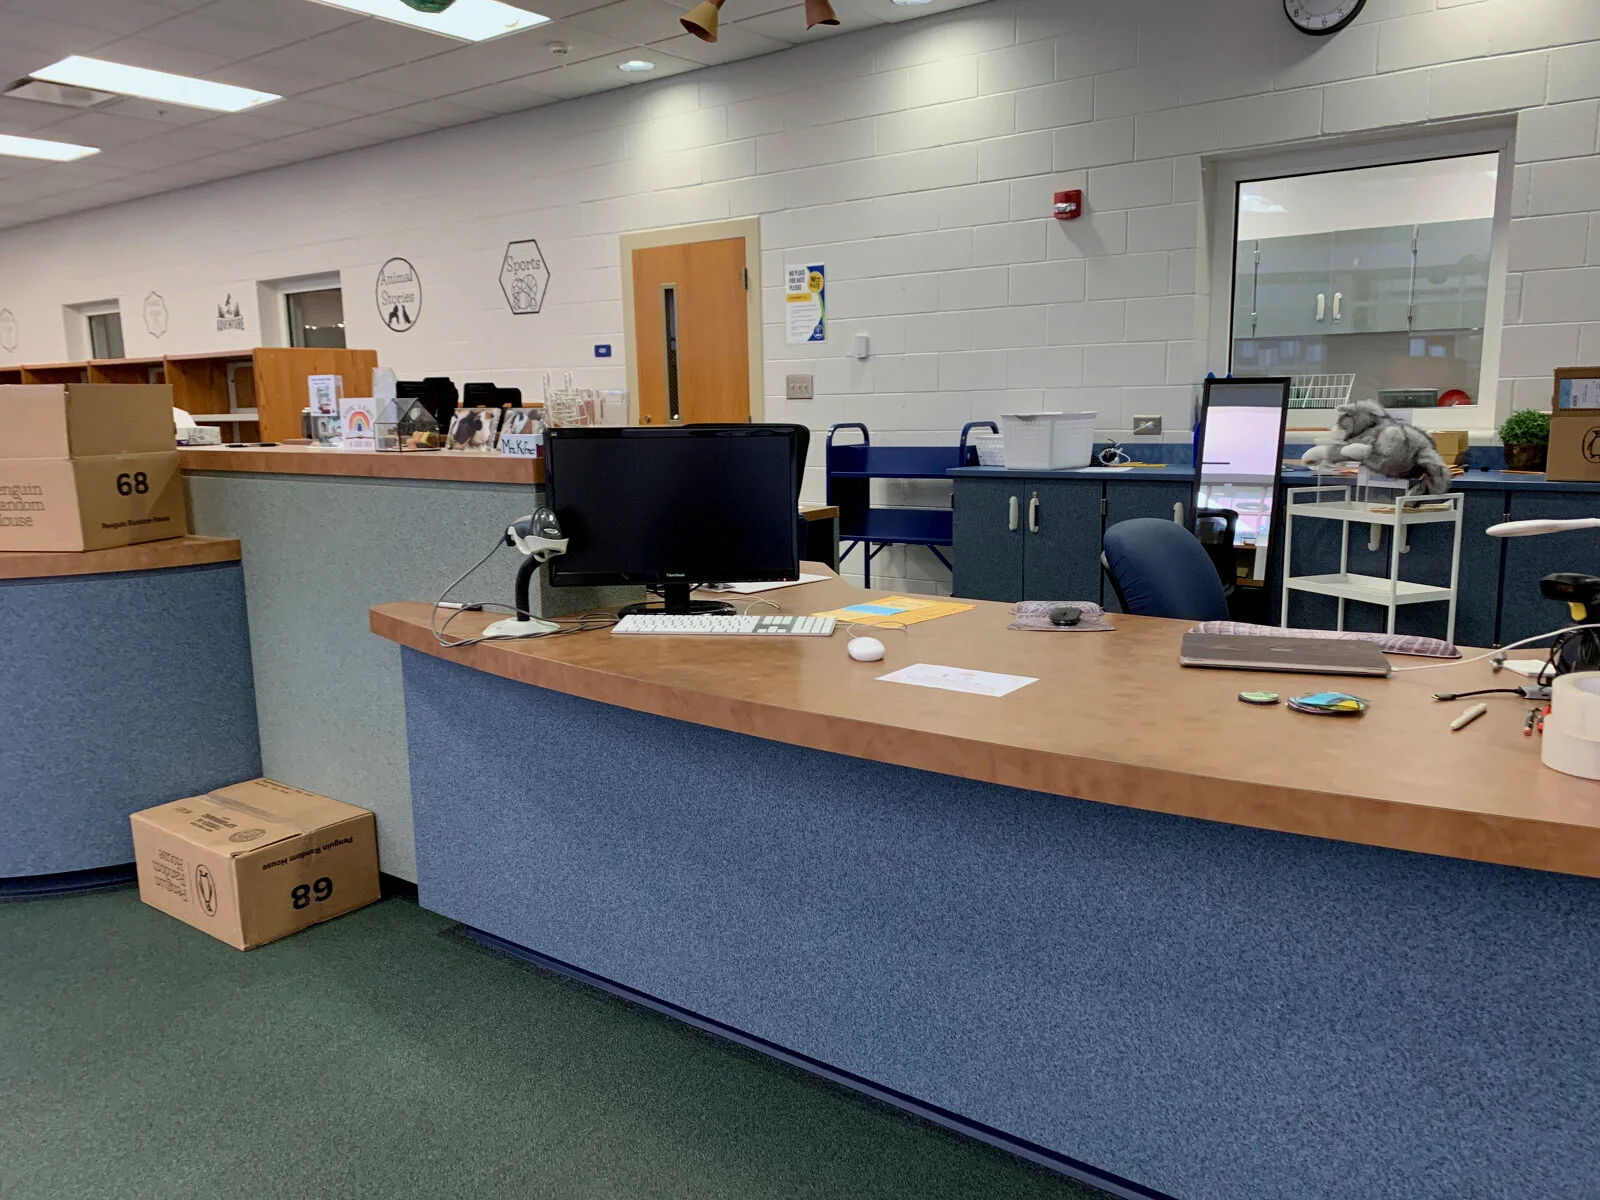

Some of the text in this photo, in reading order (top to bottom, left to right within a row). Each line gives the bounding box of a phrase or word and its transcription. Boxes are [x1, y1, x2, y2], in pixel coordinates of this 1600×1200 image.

[1294, 9, 1299, 17] 8
[506, 255, 541, 276] Sports
[380, 265, 414, 286] Animal
[380, 289, 416, 306] Stories
[216, 315, 245, 332] ADVENTURE
[0, 483, 43, 500] enguin
[117, 472, 148, 496] 68
[0, 501, 45, 511] andom
[0, 514, 33, 526] ouse
[102, 521, 127, 529] Penguin
[262, 837, 353, 870] Penguin Random House
[291, 877, 332, 909] 68
